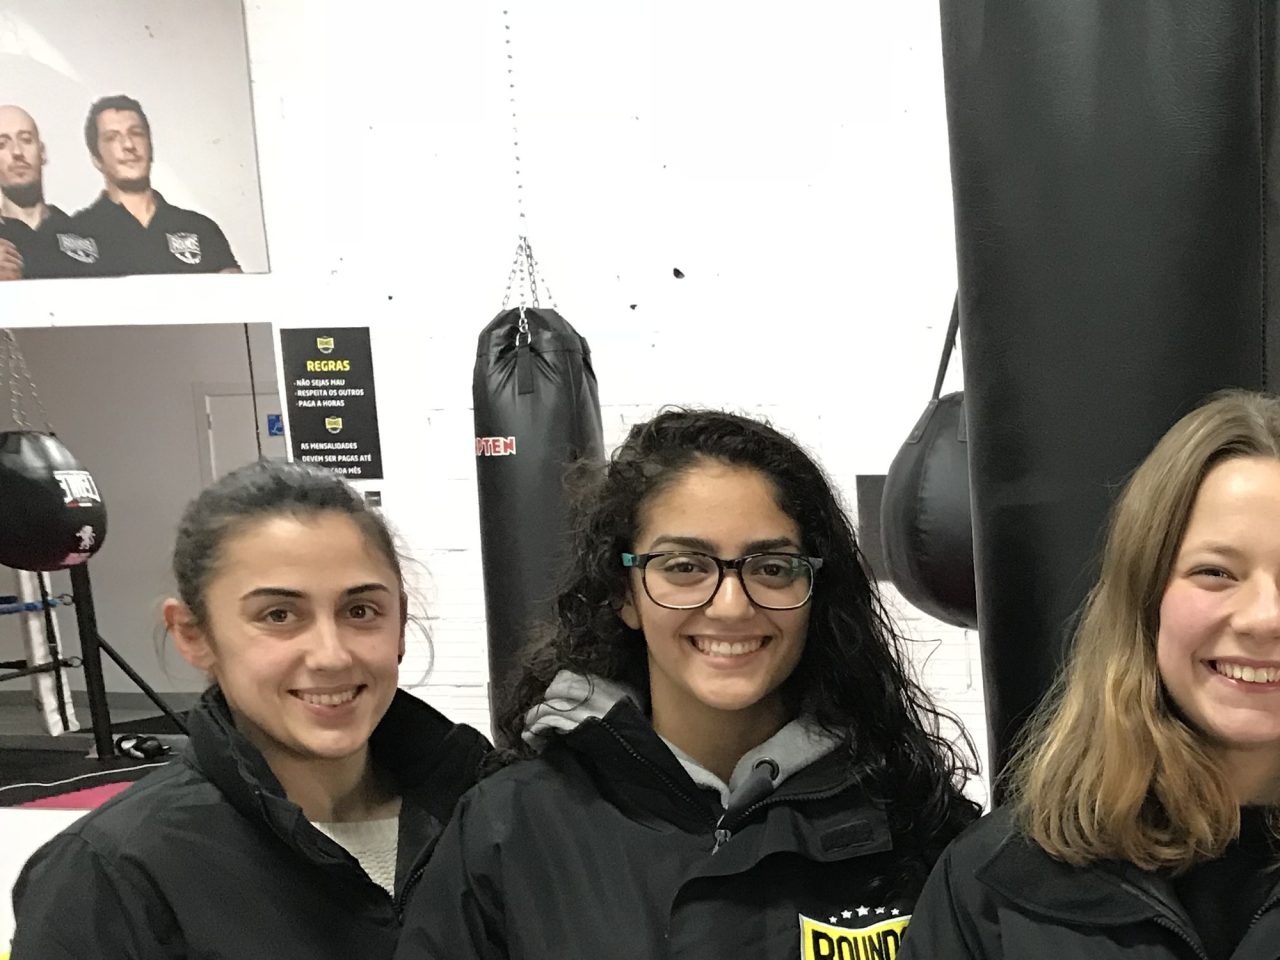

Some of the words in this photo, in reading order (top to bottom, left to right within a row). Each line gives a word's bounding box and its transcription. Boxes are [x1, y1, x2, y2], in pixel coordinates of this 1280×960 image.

[306, 360, 350, 371] REGRAS
[311, 379, 329, 387] SEJAS
[300, 442, 309, 450] AS
[310, 442, 358, 450] MENSALIDADES
[302, 454, 324, 462] DEVEM
[324, 454, 337, 462] SER
[337, 454, 358, 462] PAGAS
[359, 453, 372, 462] ATÉ
[348, 466, 362, 475] MÊS
